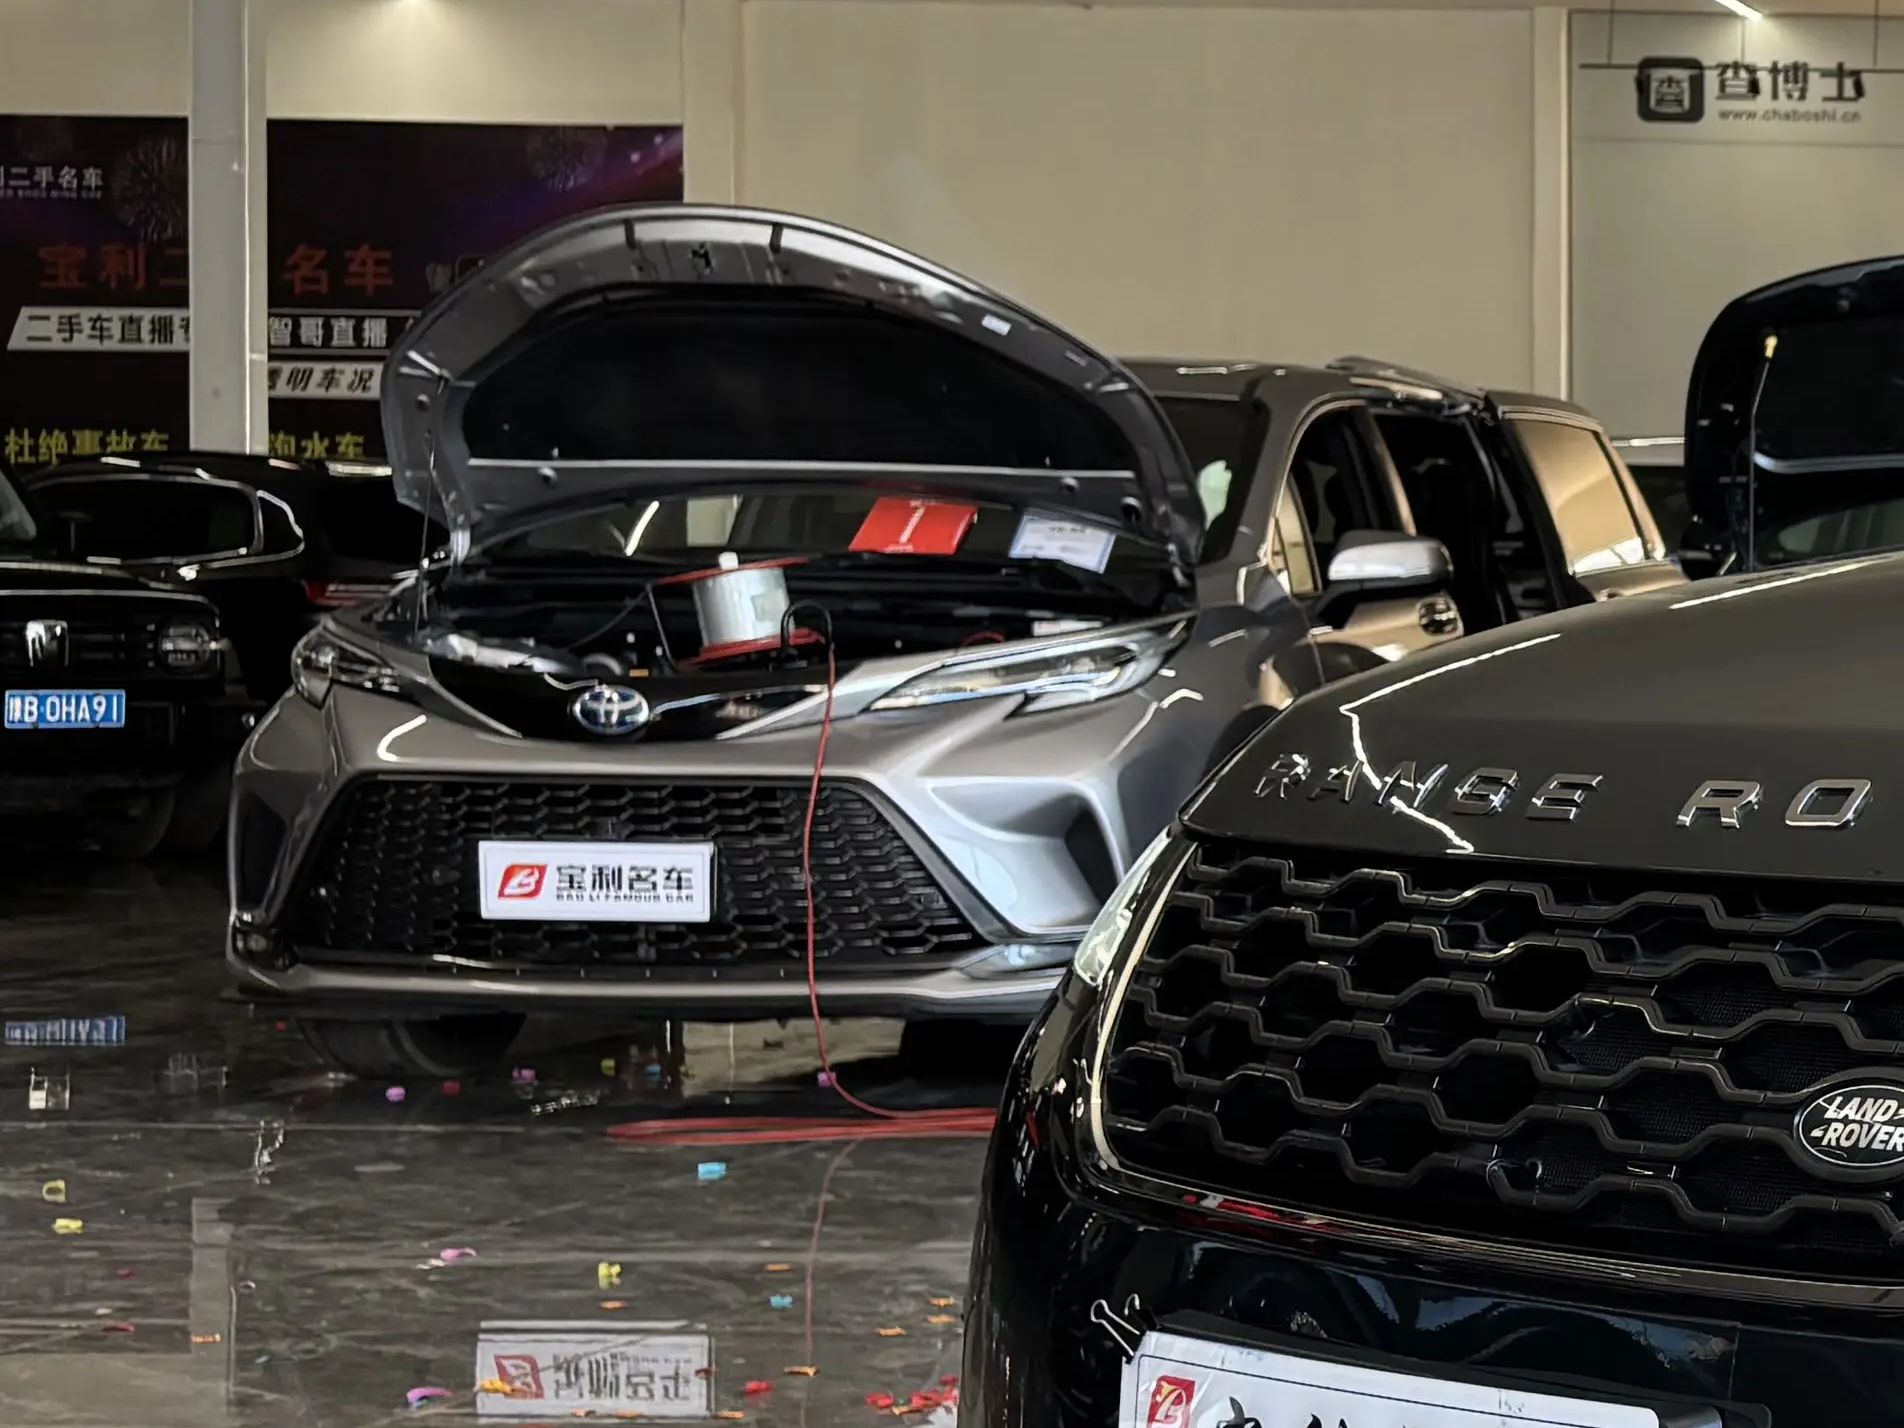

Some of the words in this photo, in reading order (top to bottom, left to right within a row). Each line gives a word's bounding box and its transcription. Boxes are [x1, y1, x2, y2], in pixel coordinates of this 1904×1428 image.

[1714, 60, 1859, 102] 查博士
[0, 165, 103, 189] 二手名车
[1252, 752, 1602, 822] RANGE
[556, 864, 694, 892] 宝利名车
[1824, 1096, 1899, 1122] LAND
